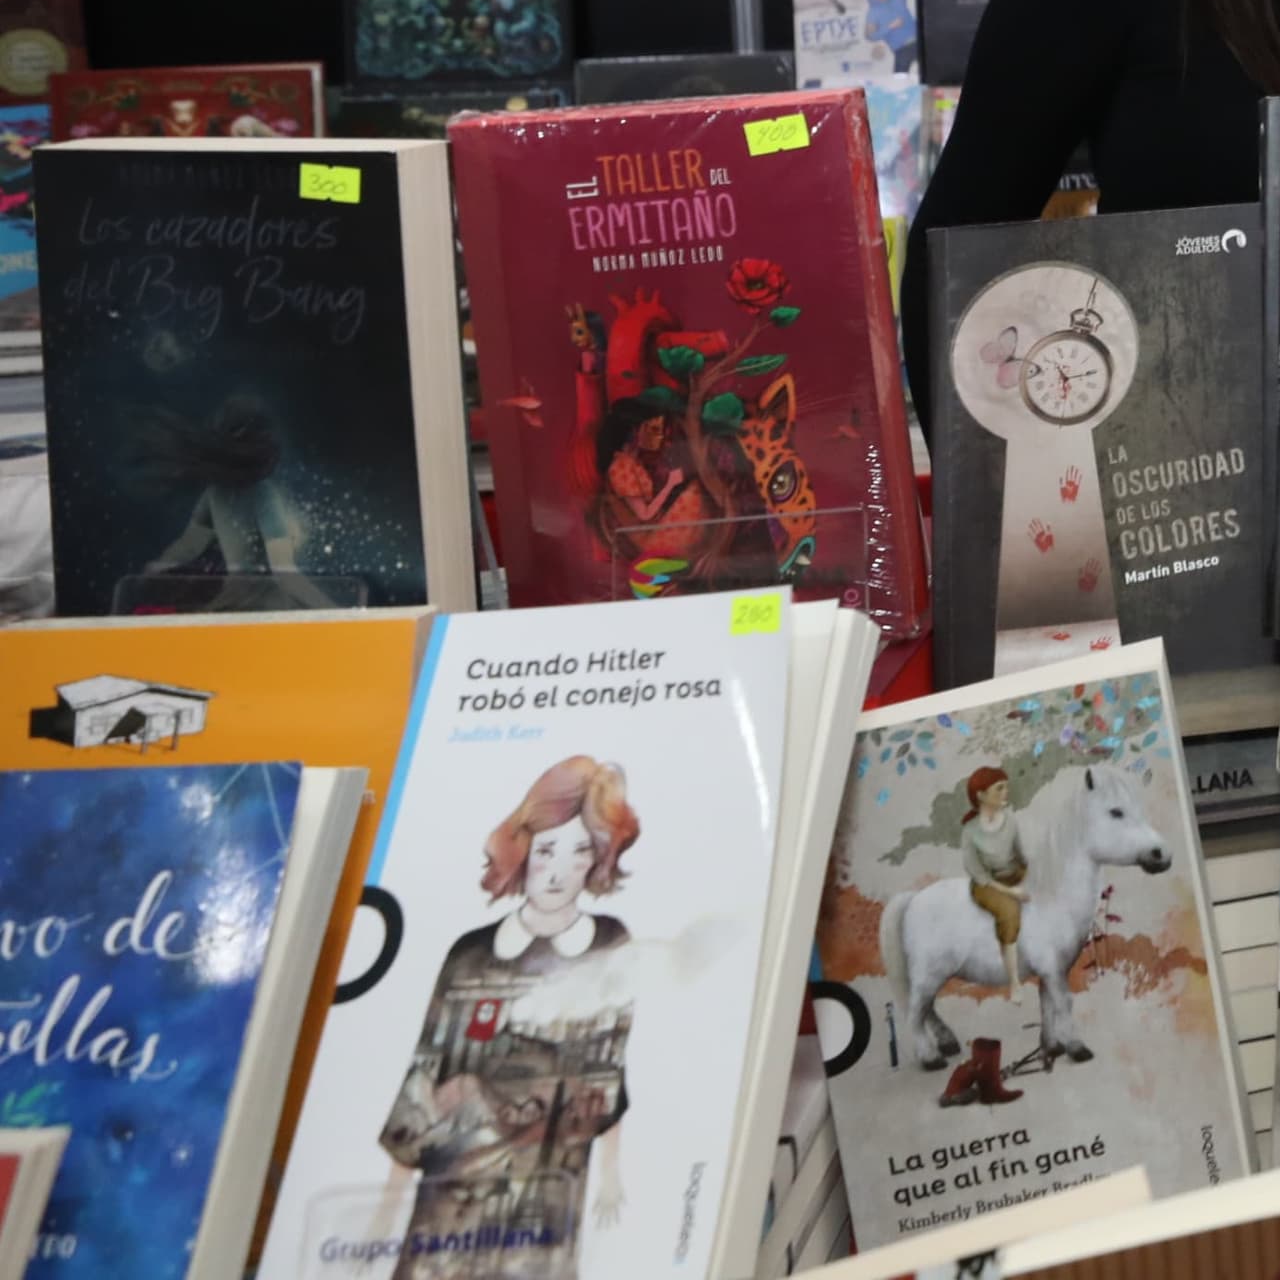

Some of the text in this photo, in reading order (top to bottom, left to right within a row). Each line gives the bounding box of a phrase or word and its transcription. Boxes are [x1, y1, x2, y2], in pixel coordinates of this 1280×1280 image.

[597, 149, 707, 196] TALLER
[710, 168, 731, 186] DEL
[80, 195, 340, 256] Los cazadores
[568, 189, 737, 251] ERMITAÑO
[593, 245, 724, 272] NORMA MUÑOZ LEDO
[235, 255, 366, 342] Bang
[1108, 447, 1128, 465] LA
[1112, 447, 1245, 498] OSCURIDAD
[1116, 499, 1171, 525] DE LOS
[1119, 508, 1241, 560] COLORES
[1124, 554, 1220, 585] Martín Blasco
[466, 647, 667, 682] Cuando Hitler
[458, 676, 722, 713] robó el conejo rosa
[104, 870, 205, 958] de
[0, 975, 178, 1083] ellas
[886, 1126, 1031, 1176] La guerra
[893, 1135, 1106, 1208] que al fin gané
[1199, 1124, 1222, 1187] loquele
[897, 1186, 1049, 1233] Kimberly Brubaker
[320, 1222, 555, 1265] Grupo Santillana
